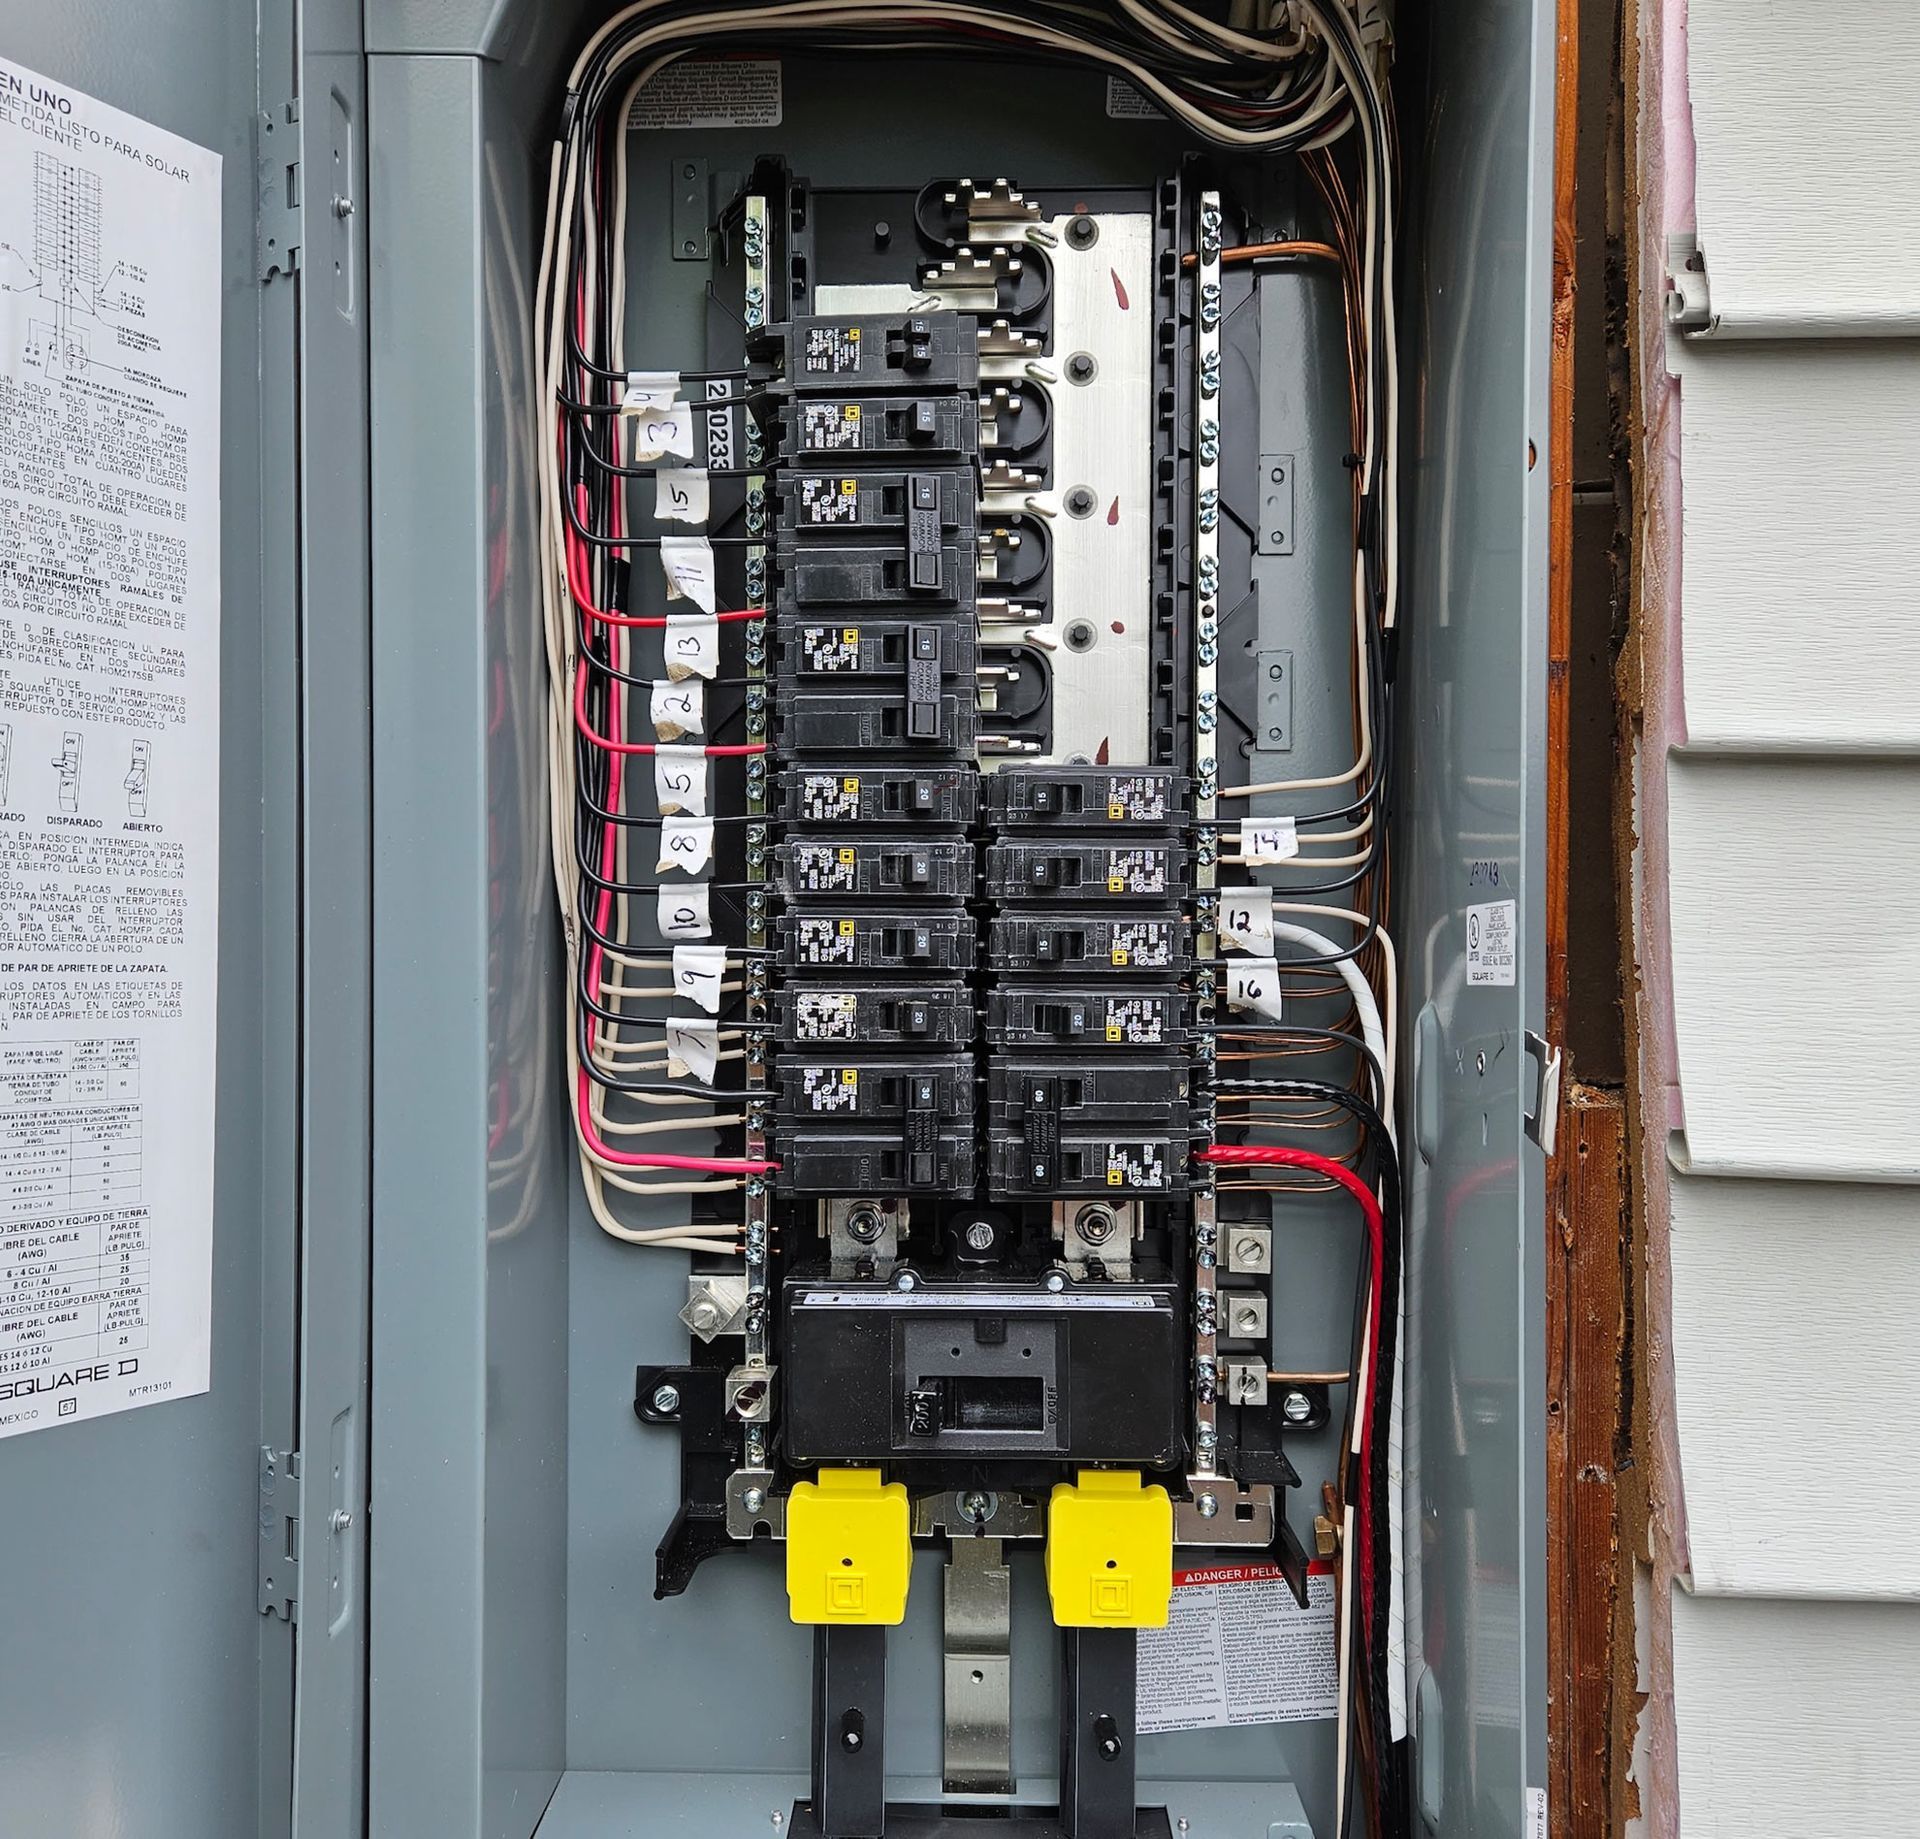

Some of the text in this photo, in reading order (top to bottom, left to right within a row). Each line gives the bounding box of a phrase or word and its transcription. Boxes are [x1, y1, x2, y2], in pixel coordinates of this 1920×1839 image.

[30, 84, 71, 116] UNO
[21, 115, 82, 152] CLIENTE
[59, 116, 100, 144] LISTO
[104, 136, 141, 162] PARA
[145, 153, 189, 183] SOLAR
[915, 320, 924, 331] 15
[917, 346, 926, 357] 15
[24, 381, 50, 397] SOLO
[96, 403, 109, 414] UN
[117, 409, 157, 428] ESPACIO
[164, 423, 187, 436] PARA
[922, 410, 931, 422] 15
[648, 421, 678, 443] 3
[85, 428, 122, 447] PUEDEN
[126, 440, 186, 464] CONECTARSE
[74, 455, 87, 466] EN
[145, 474, 187, 492] LUGARES
[23, 473, 186, 521] CIRCUITOS NO DEBE EXCEDER DE
[672, 483, 689, 511] 15
[921, 487, 930, 498] 15
[28, 565, 182, 604] INTERRUPTORES RAMALES DE
[28, 634, 185, 668] SOBRECORRIENTE SECUNDARIA
[677, 636, 702, 656] 13
[922, 639, 930, 650] 15
[44, 676, 185, 704] UTILICE INTERRUPTORES
[4, 700, 58, 716] REPUESTO
[62, 708, 82, 719] CON
[86, 712, 109, 722] ESTE
[664, 696, 692, 711] 2
[666, 766, 692, 793] 5
[920, 788, 928, 800] 20
[1038, 792, 1046, 803] 15
[47, 816, 162, 832] DISPARADO ABIERTO
[670, 835, 698, 852] 8
[1253, 832, 1285, 855] 14
[43, 853, 78, 863] PONGA
[86, 856, 97, 864] LA
[106, 857, 144, 867] PALANCA
[155, 860, 166, 868] EN
[917, 862, 925, 874] 20
[1036, 866, 1044, 877] 15
[40, 883, 183, 897] LAS PLACAS REMOVIBLES
[668, 908, 701, 931] 10
[1229, 911, 1252, 932] 12
[918, 936, 925, 948] 20
[1040, 940, 1048, 951] 15
[2, 964, 14, 972] DE
[18, 964, 38, 972] PAR
[682, 970, 716, 986] 9
[1237, 979, 1263, 999] 16
[915, 1012, 923, 1024] 20
[1074, 1015, 1082, 1026] 20
[677, 1030, 708, 1049] 7
[921, 1087, 929, 1099] 30
[1035, 1090, 1043, 1102] 60
[1036, 1165, 1044, 1177] 60
[6, 1208, 148, 1233] DERIVADO Y EQUIPO DE TIERRA
[110, 1220, 139, 1232] PAR DE
[28, 1232, 79, 1247] DEL CABLE
[108, 1230, 141, 1242] APRIETE
[18, 1248, 47, 1261] (AWG)
[120, 1253, 129, 1262] 35
[120, 1265, 129, 1273] 25
[120, 1277, 129, 1285] 20
[11, 1349, 21, 1359] 14
[30, 1345, 40, 1356] 12
[42, 1343, 52, 1353] Cu
[0, 1357, 137, 1400] SQUARE D
[62, 1401, 73, 1412] 67
[129, 1380, 172, 1397] MTR13101
[914, 1400, 930, 1429] 200
[1194, 1570, 1242, 1582] DANGER
